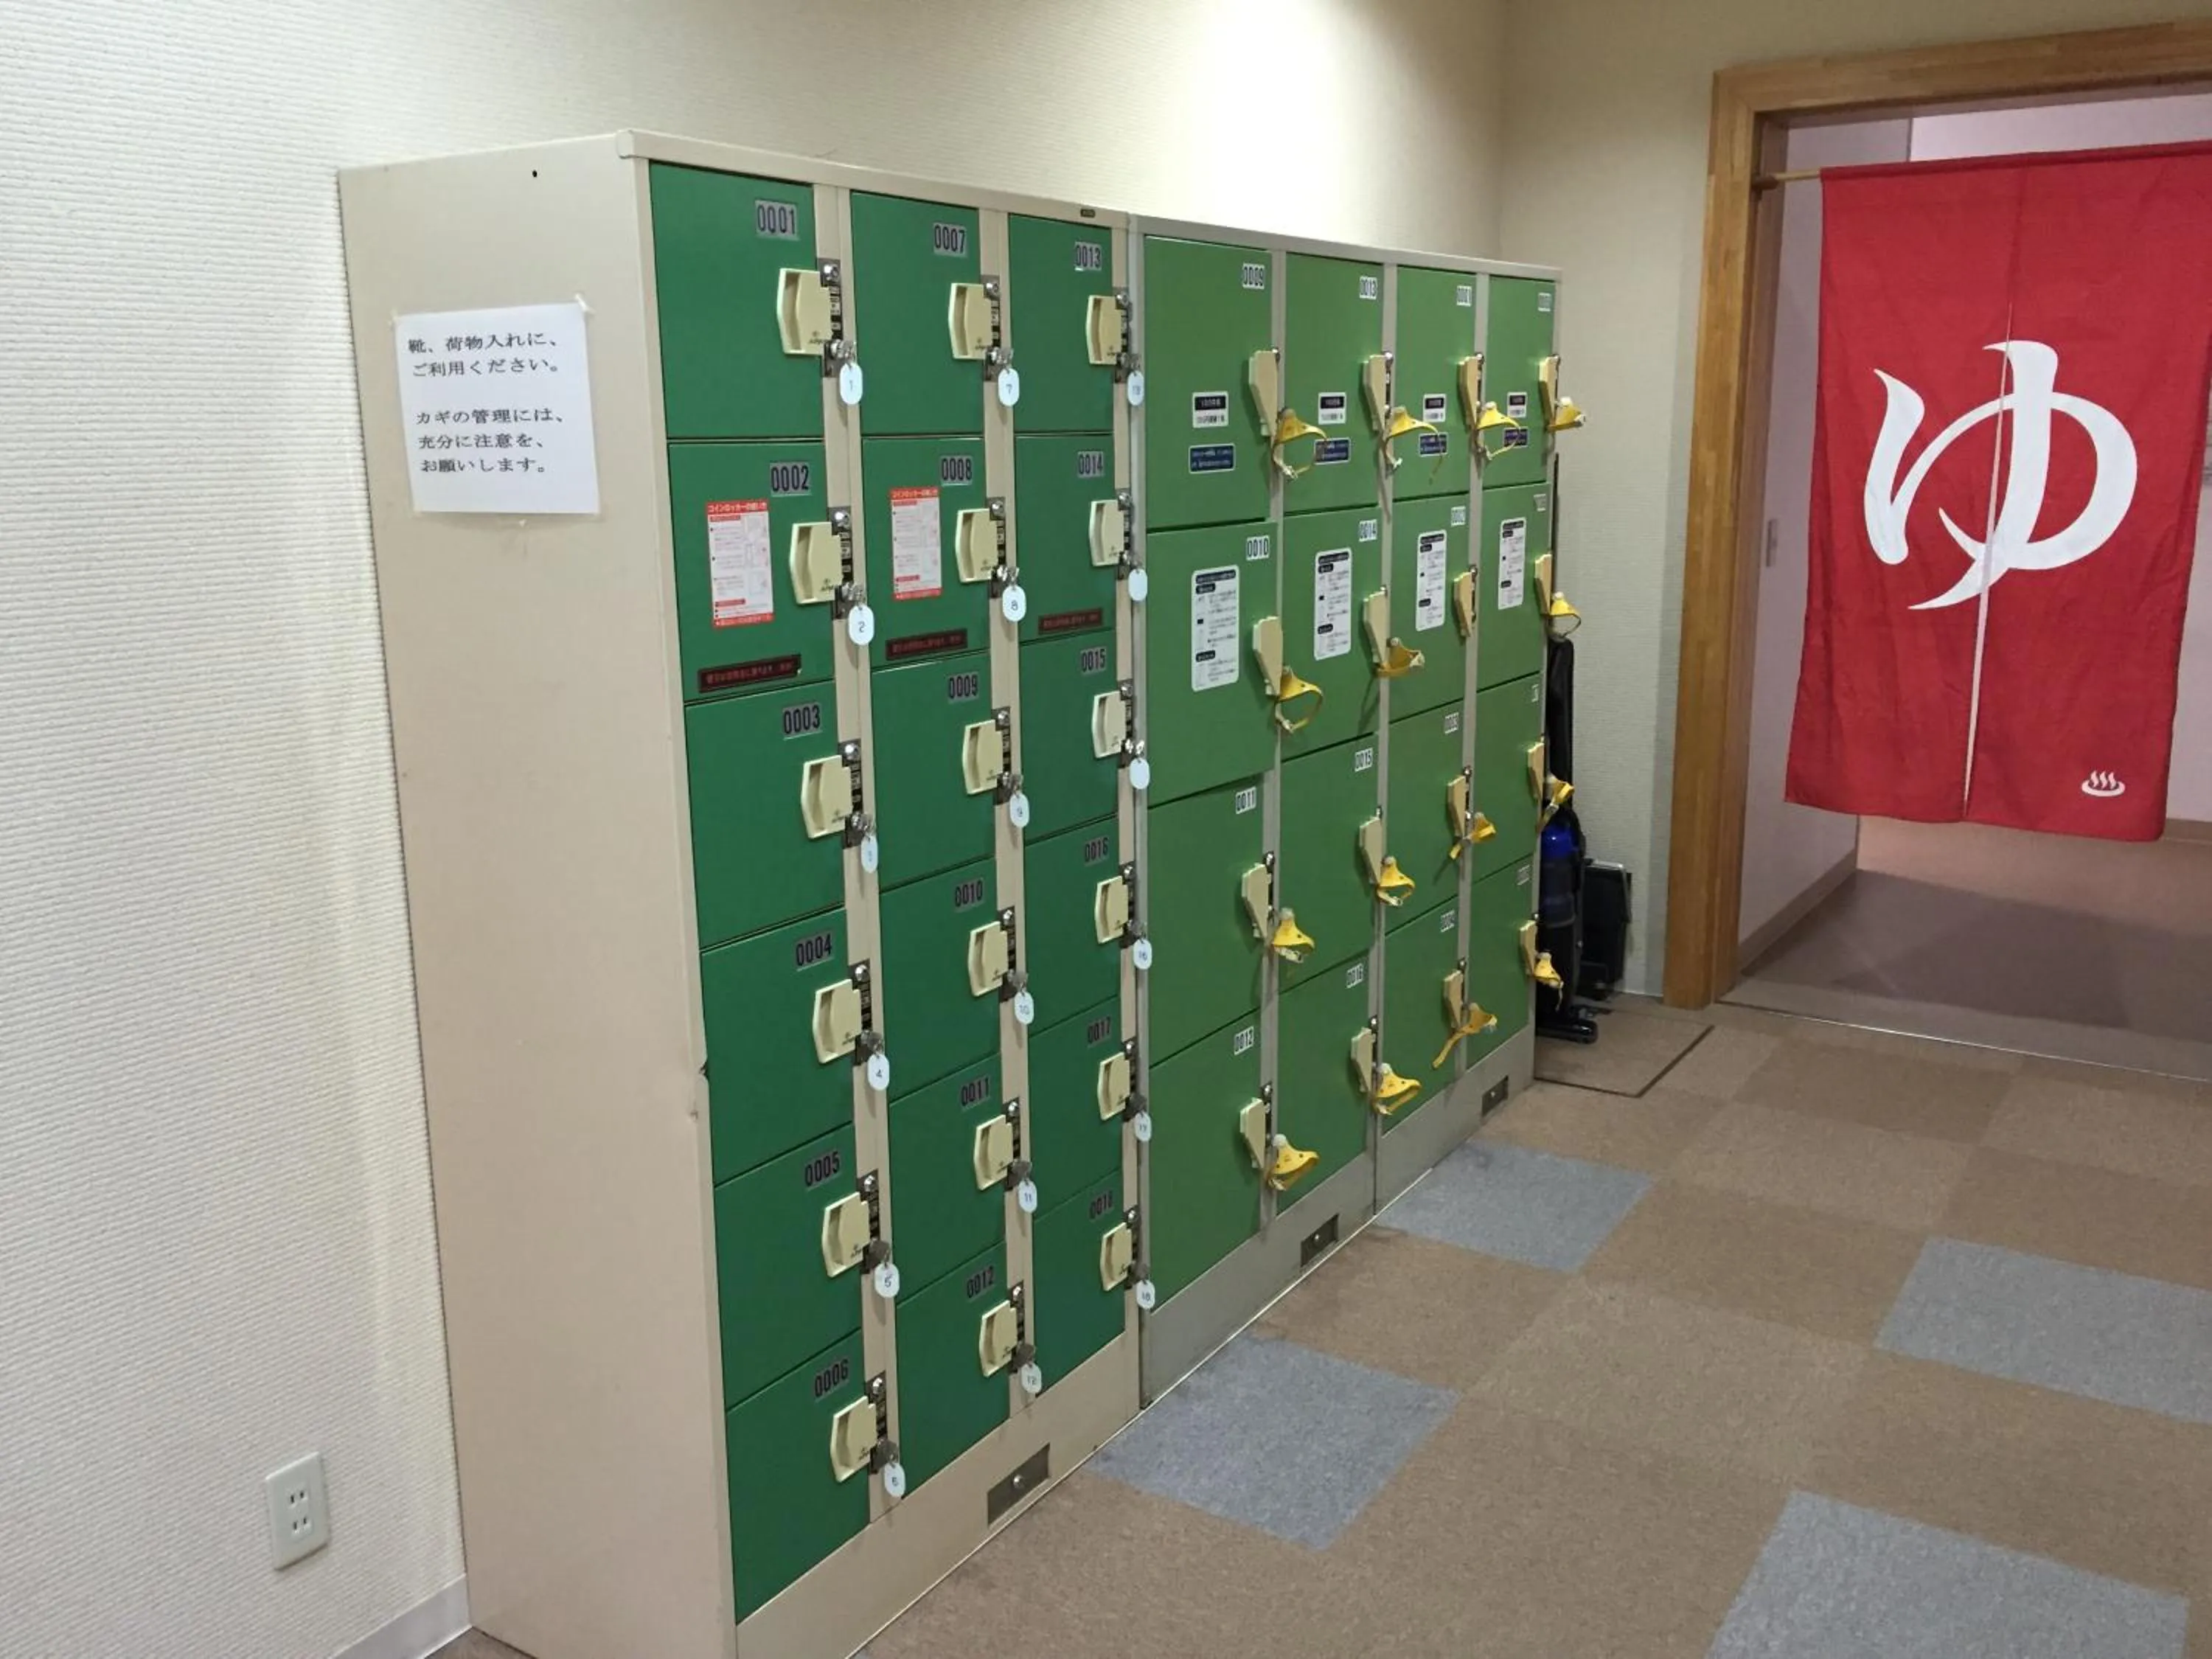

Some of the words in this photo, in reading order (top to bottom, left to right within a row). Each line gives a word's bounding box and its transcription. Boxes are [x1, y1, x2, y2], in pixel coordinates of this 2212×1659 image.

[757, 204, 796, 234] 0001
[934, 224, 966, 254] 0007
[1075, 244, 1102, 268] 0013
[408, 332, 557, 353] 靴、荷物入れに、
[413, 358, 558, 377] ご利用ください。
[416, 408, 563, 425] カギの管理には、
[418, 433, 544, 449] 充分に注意を、
[420, 457, 545, 473] お願いします。
[942, 457, 973, 482] 0008
[1077, 454, 1103, 475] 0014
[1863, 338, 2138, 610] ゆ
[771, 465, 810, 492] 0002
[1247, 538, 1269, 557] 0010
[858, 621, 866, 633] 2
[1081, 648, 1106, 672] 0015
[948, 674, 978, 699] 0009
[784, 704, 821, 734] 0003
[1084, 837, 1109, 863] 0016
[955, 879, 983, 908] 0010
[796, 933, 832, 967] 0004
[961, 1077, 990, 1106] 0011
[804, 1151, 841, 1187] 0005
[885, 1274, 892, 1288] 5
[966, 1265, 994, 1298] 0012
[815, 1358, 849, 1397] 0006
